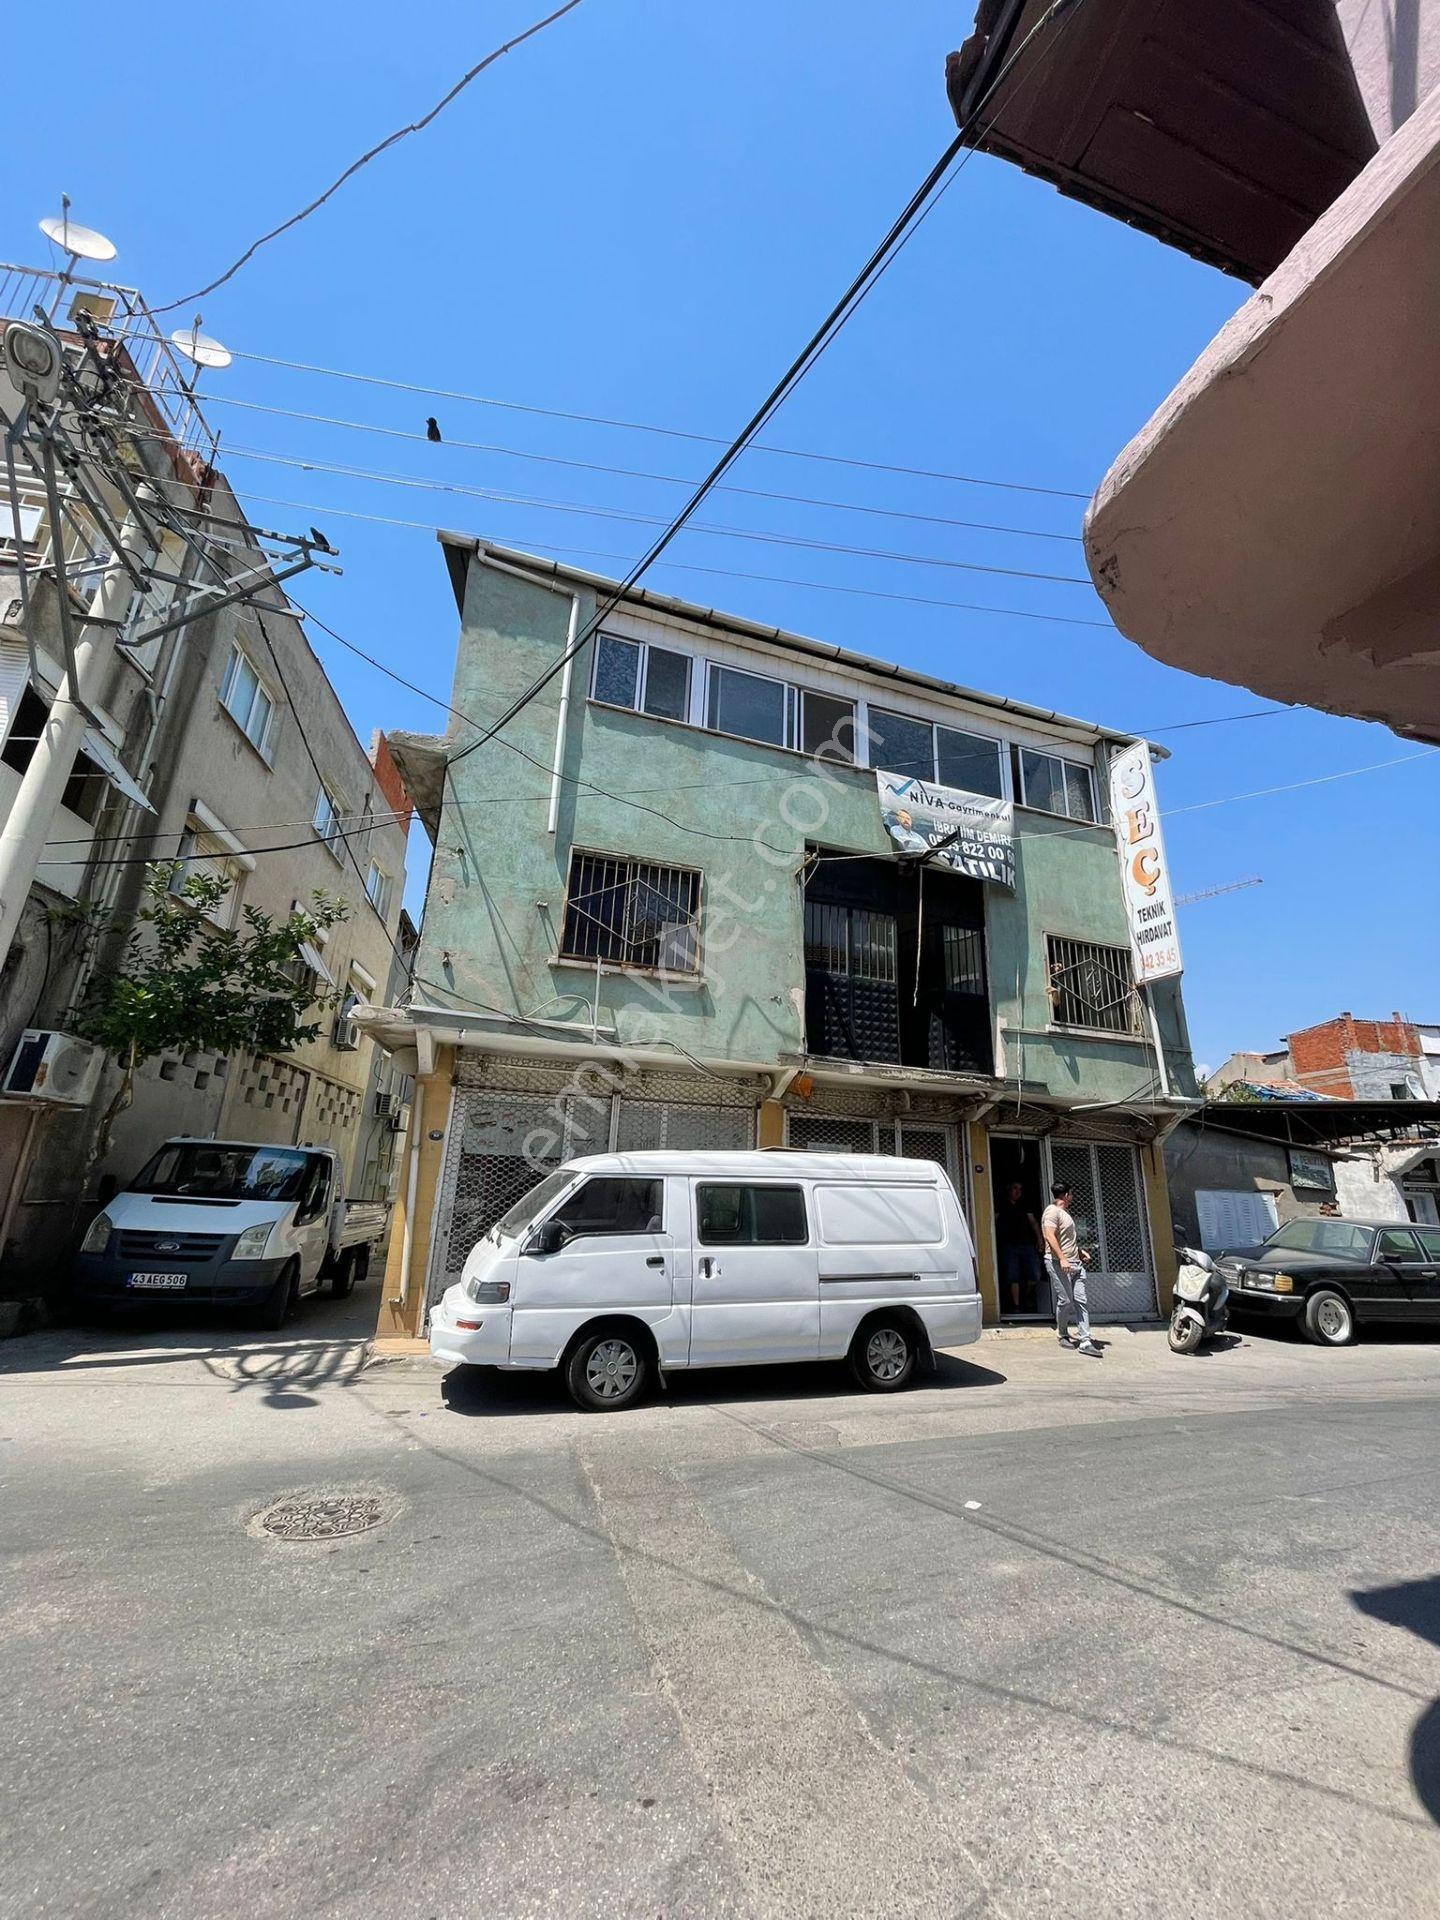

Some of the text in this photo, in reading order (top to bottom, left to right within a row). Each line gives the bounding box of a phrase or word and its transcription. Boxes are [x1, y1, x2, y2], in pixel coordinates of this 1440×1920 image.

[909, 790, 1011, 821] NİVA Gayrimenkul
[961, 840, 986, 858] 822
[987, 845, 1005, 860] 00
[976, 830, 1015, 849] DEMİRE
[937, 850, 1016, 890] SATILIK
[1137, 900, 1166, 924] TEKNİK
[1136, 921, 1172, 946] HIRDAVAT
[132, 1274, 185, 1285] 43 AEG 506
